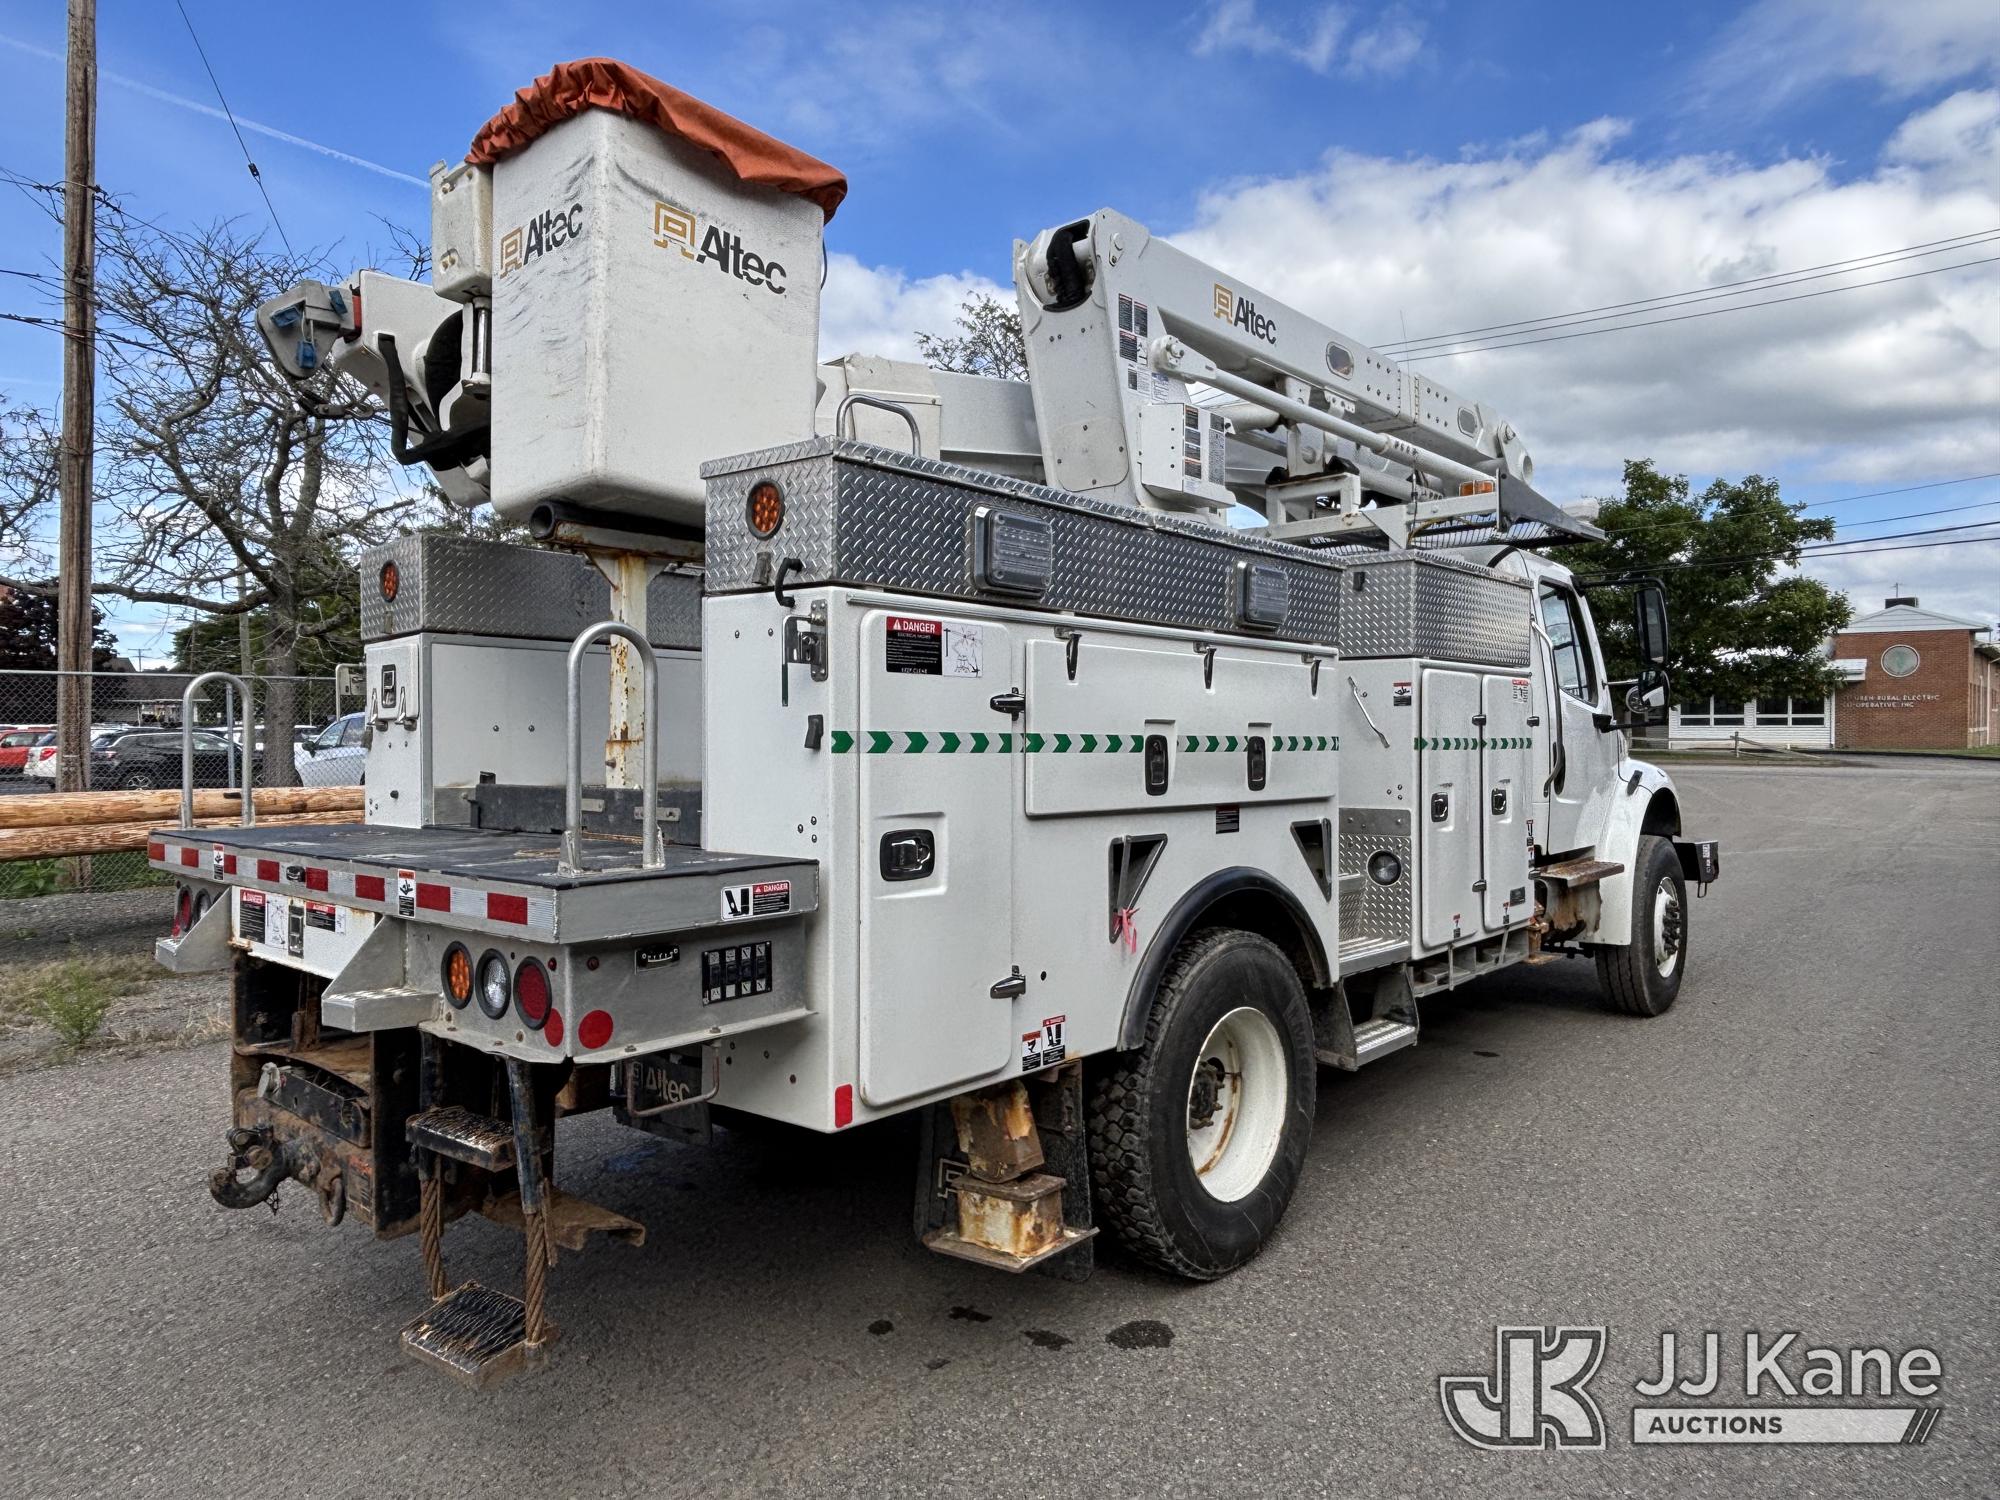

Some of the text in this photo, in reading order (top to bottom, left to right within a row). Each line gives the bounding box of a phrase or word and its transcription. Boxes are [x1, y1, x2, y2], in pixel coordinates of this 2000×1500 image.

[524, 202, 584, 266] Altec
[696, 224, 787, 295] Altec
[1234, 296, 1277, 345] Altec
[903, 620, 936, 633] DANGER
[646, 1066, 691, 1103] Altec
